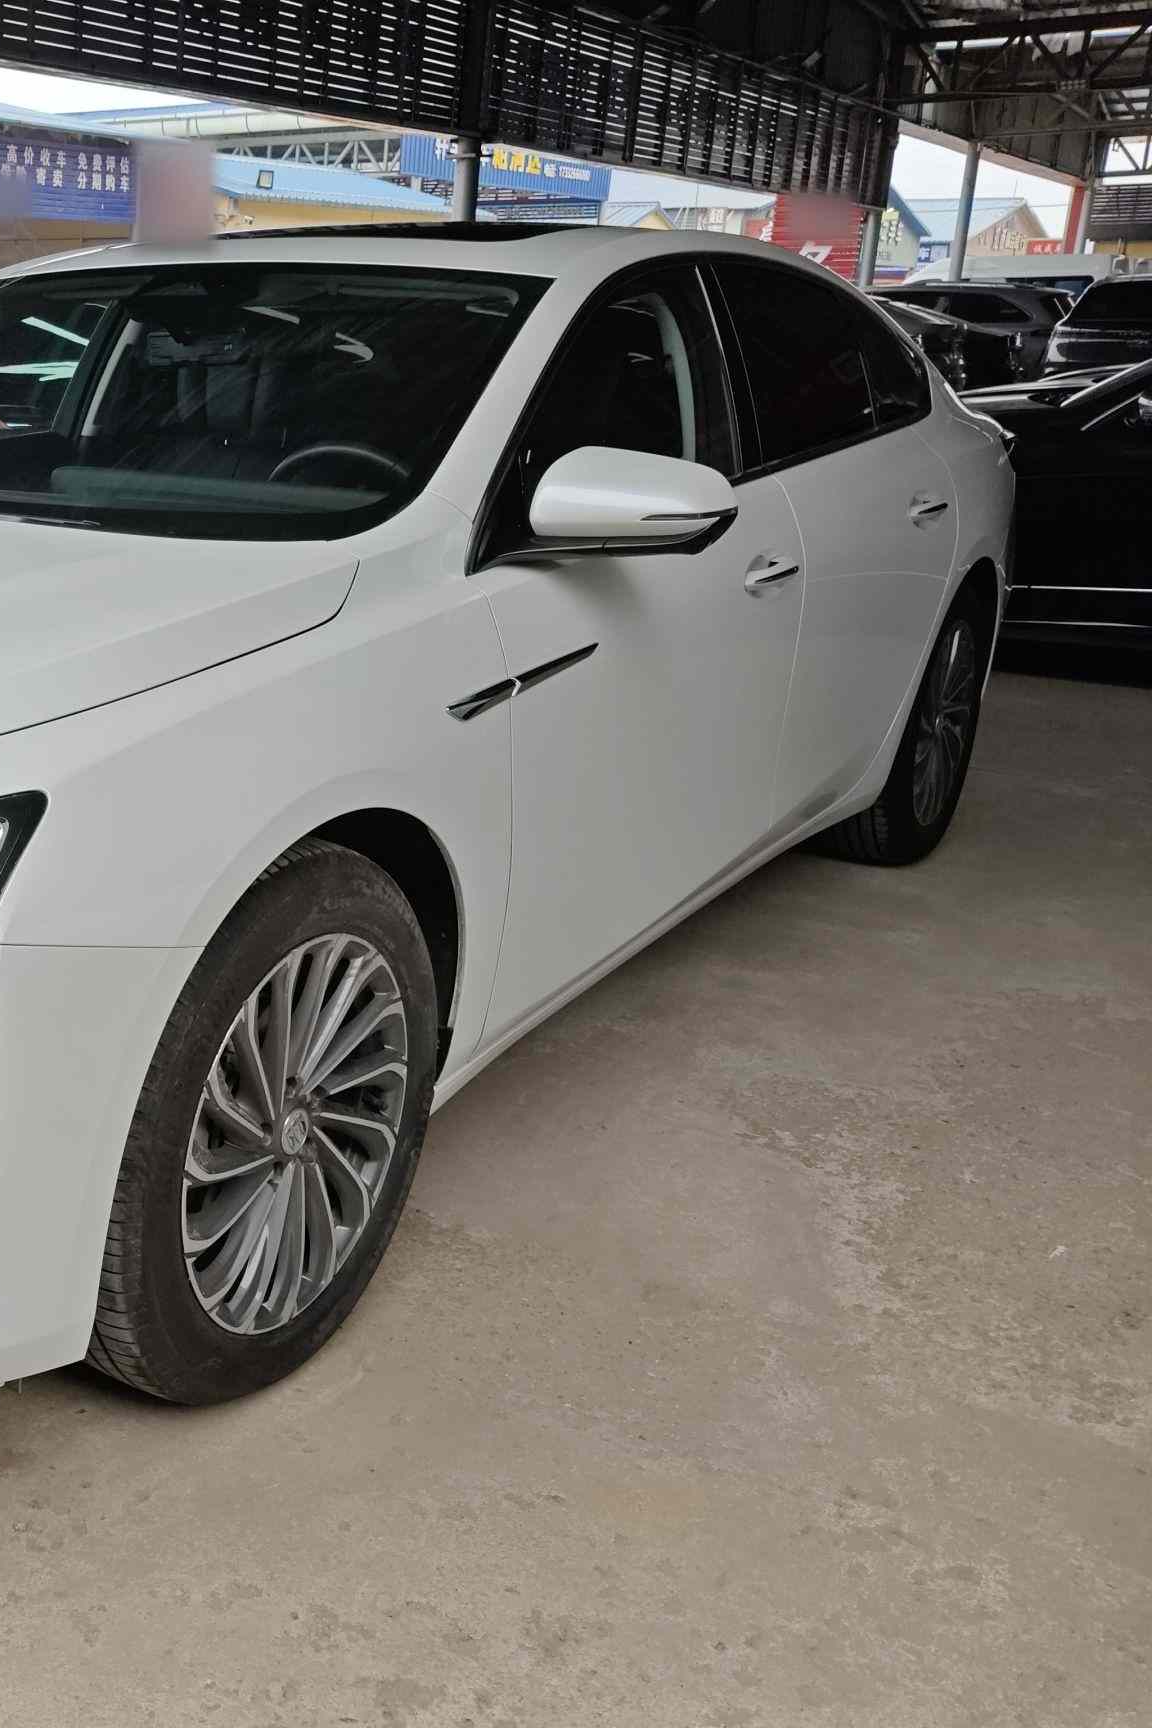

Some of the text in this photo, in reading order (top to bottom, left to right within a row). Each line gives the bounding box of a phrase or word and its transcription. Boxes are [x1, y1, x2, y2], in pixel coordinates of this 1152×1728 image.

[6, 143, 67, 169] 高价收车
[77, 151, 130, 175] 免费评估
[77, 171, 131, 193] 分期购车
